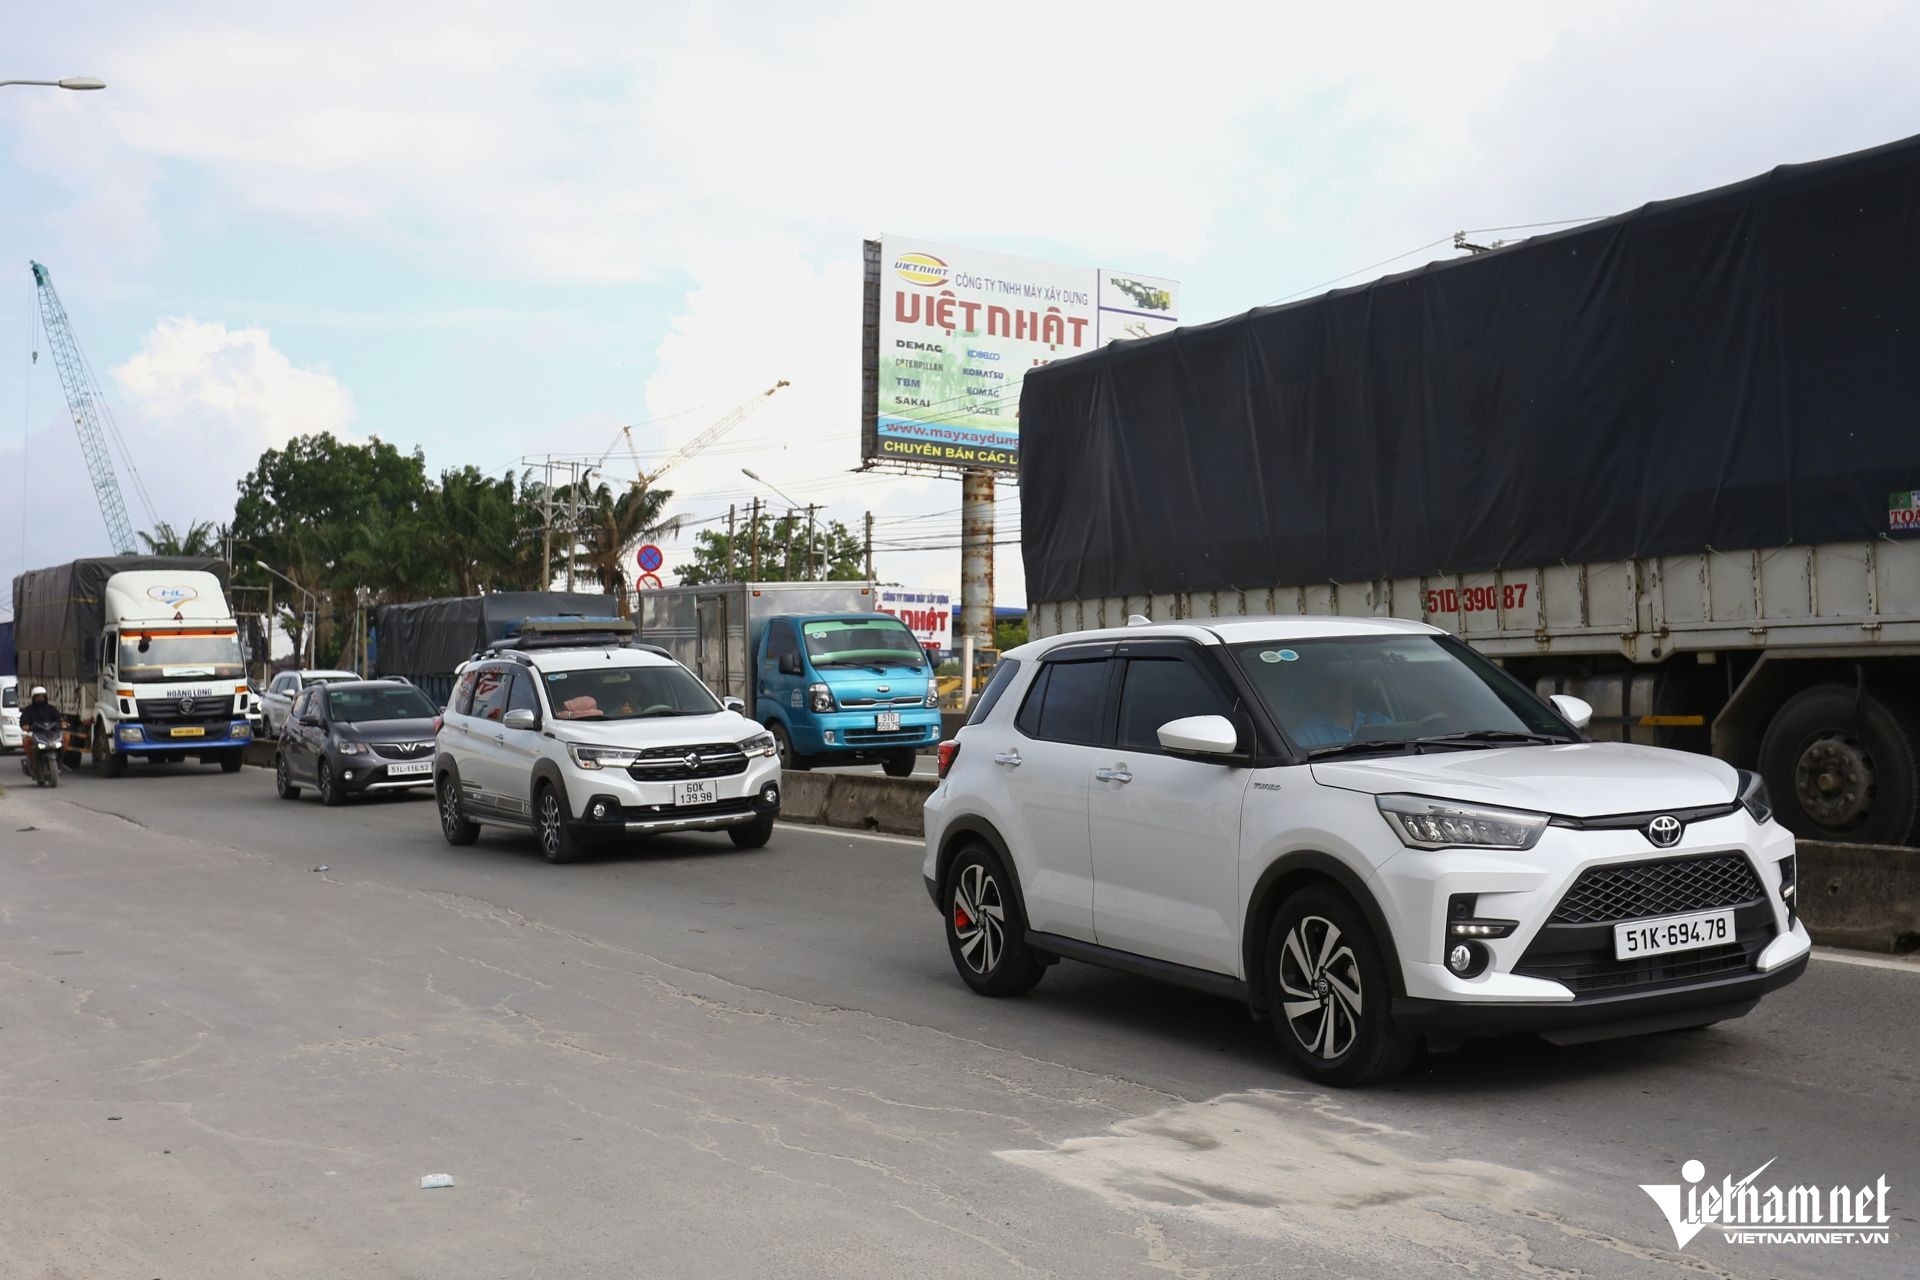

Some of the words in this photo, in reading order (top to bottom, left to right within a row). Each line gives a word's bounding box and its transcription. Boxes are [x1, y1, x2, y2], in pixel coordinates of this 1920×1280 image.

[956, 272, 982, 290] CÔNG
[985, 278, 996, 293] TY
[998, 280, 1021, 297] TNHH
[1024, 282, 1043, 299] MÁY
[1044, 285, 1061, 302] XÂY
[1063, 290, 1088, 307] DỰNG
[896, 339, 942, 353] DEMAG
[896, 358, 943, 372] CATERPILLAR
[963, 367, 1004, 380] KOMATSU
[896, 377, 921, 388] TBM
[896, 396, 930, 408] SAKAI
[884, 440, 941, 457] CHUYÊN
[945, 446, 974, 460] BÁN
[978, 450, 1006, 464] CÁC
[1009, 454, 1019, 465] L
[1427, 588, 1459, 613] 51D
[1463, 585, 1497, 612] 390
[1503, 583, 1528, 610] 87
[193, 688, 212, 697] LONG
[686, 781, 704, 793] 60K
[680, 791, 713, 804] 139.98
[1627, 917, 1726, 952] 51K-694.78
